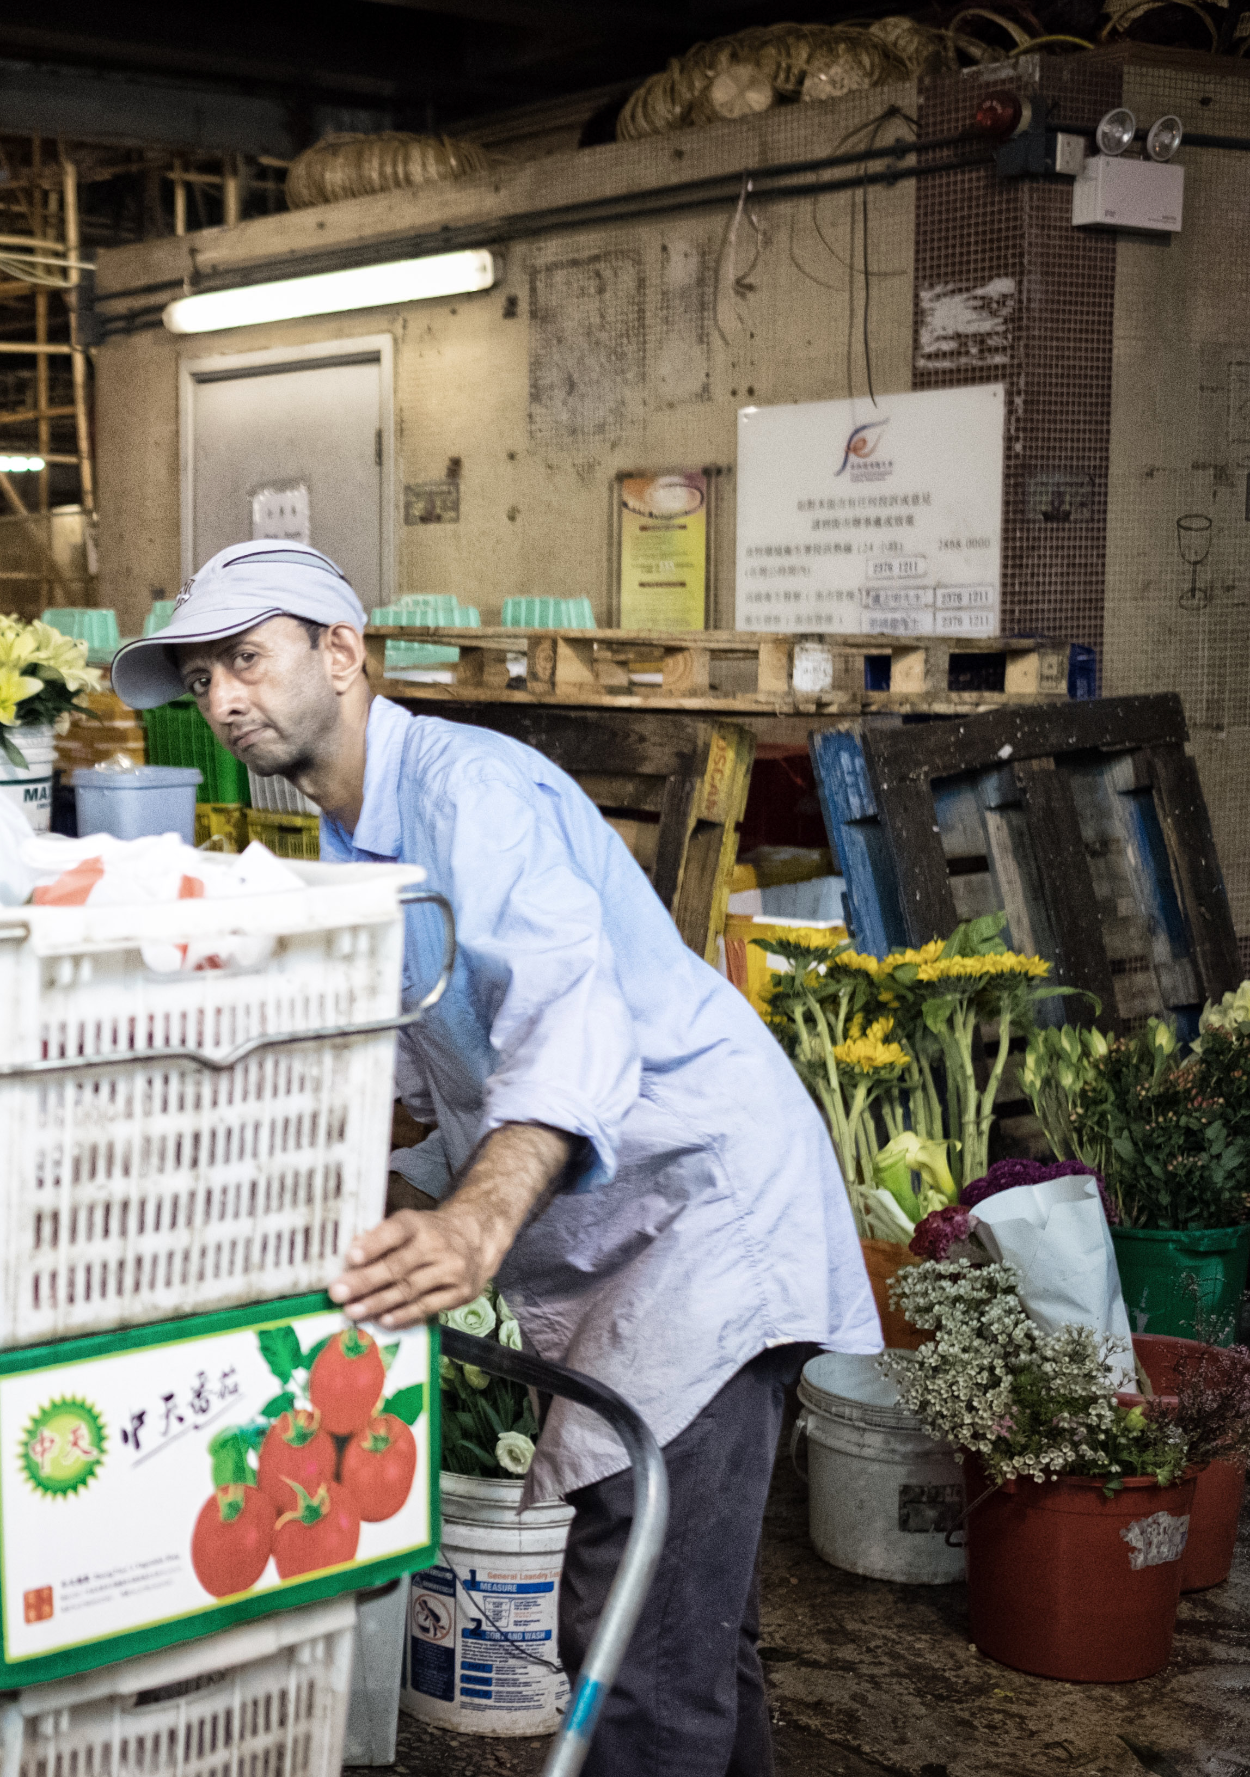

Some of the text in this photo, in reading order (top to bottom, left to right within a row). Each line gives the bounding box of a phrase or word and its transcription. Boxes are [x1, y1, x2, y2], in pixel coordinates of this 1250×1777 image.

[479, 1582, 518, 1593] MEASURE
[468, 1617, 483, 1637] 2
[524, 1631, 546, 1640] WASH
